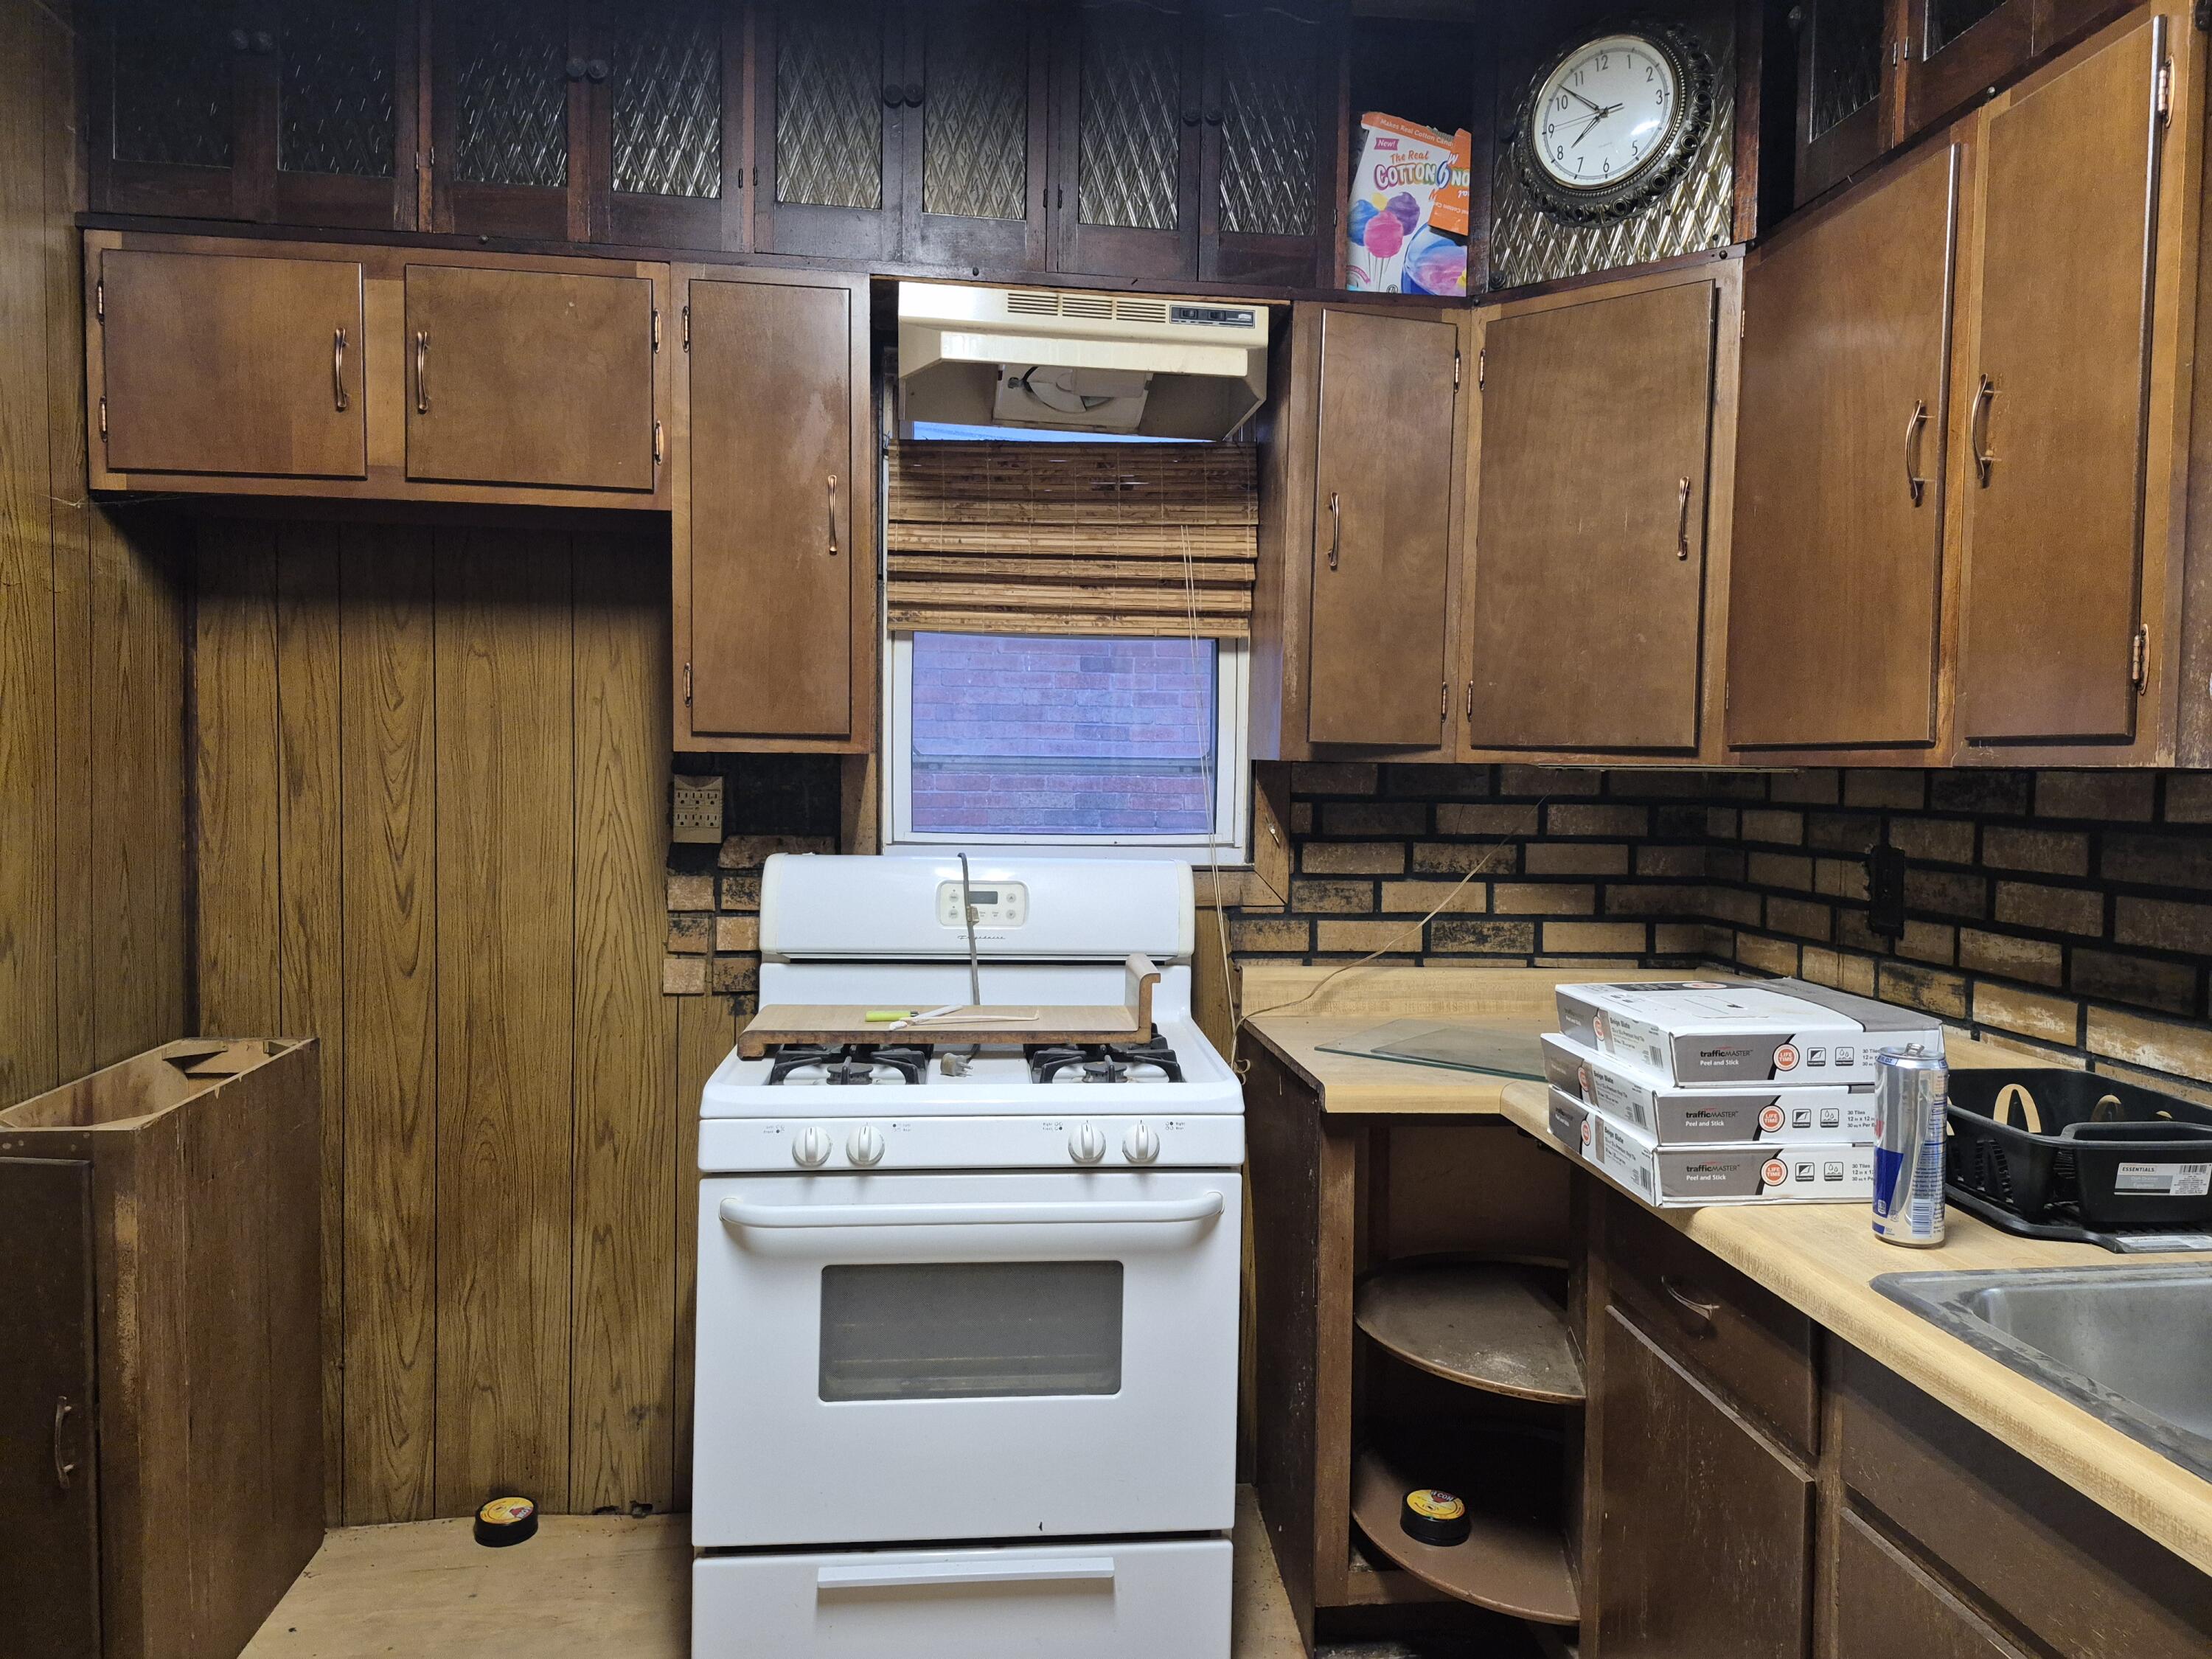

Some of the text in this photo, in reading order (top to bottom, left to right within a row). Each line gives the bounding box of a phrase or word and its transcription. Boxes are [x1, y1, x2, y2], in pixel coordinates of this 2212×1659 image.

[1595, 55, 1609, 72] 12
[1627, 55, 1632, 69] 1
[1573, 70, 1585, 87] 11
[1646, 66, 1654, 83] 2
[1556, 94, 1568, 111] 10
[1655, 89, 1663, 105] 3
[1380, 119, 1399, 128] Makes
[1400, 125, 1414, 135] Real
[1414, 130, 1435, 142] Cotton
[1548, 123, 1555, 139] 9
[1378, 139, 1396, 147] New!
[1632, 140, 1638, 156] 5
[1390, 150, 1430, 164] The Real
[1557, 145, 1564, 160] 8
[1577, 157, 1584, 173] 7
[1603, 158, 1610, 173] 6
[1374, 163, 1437, 190] COTTON
